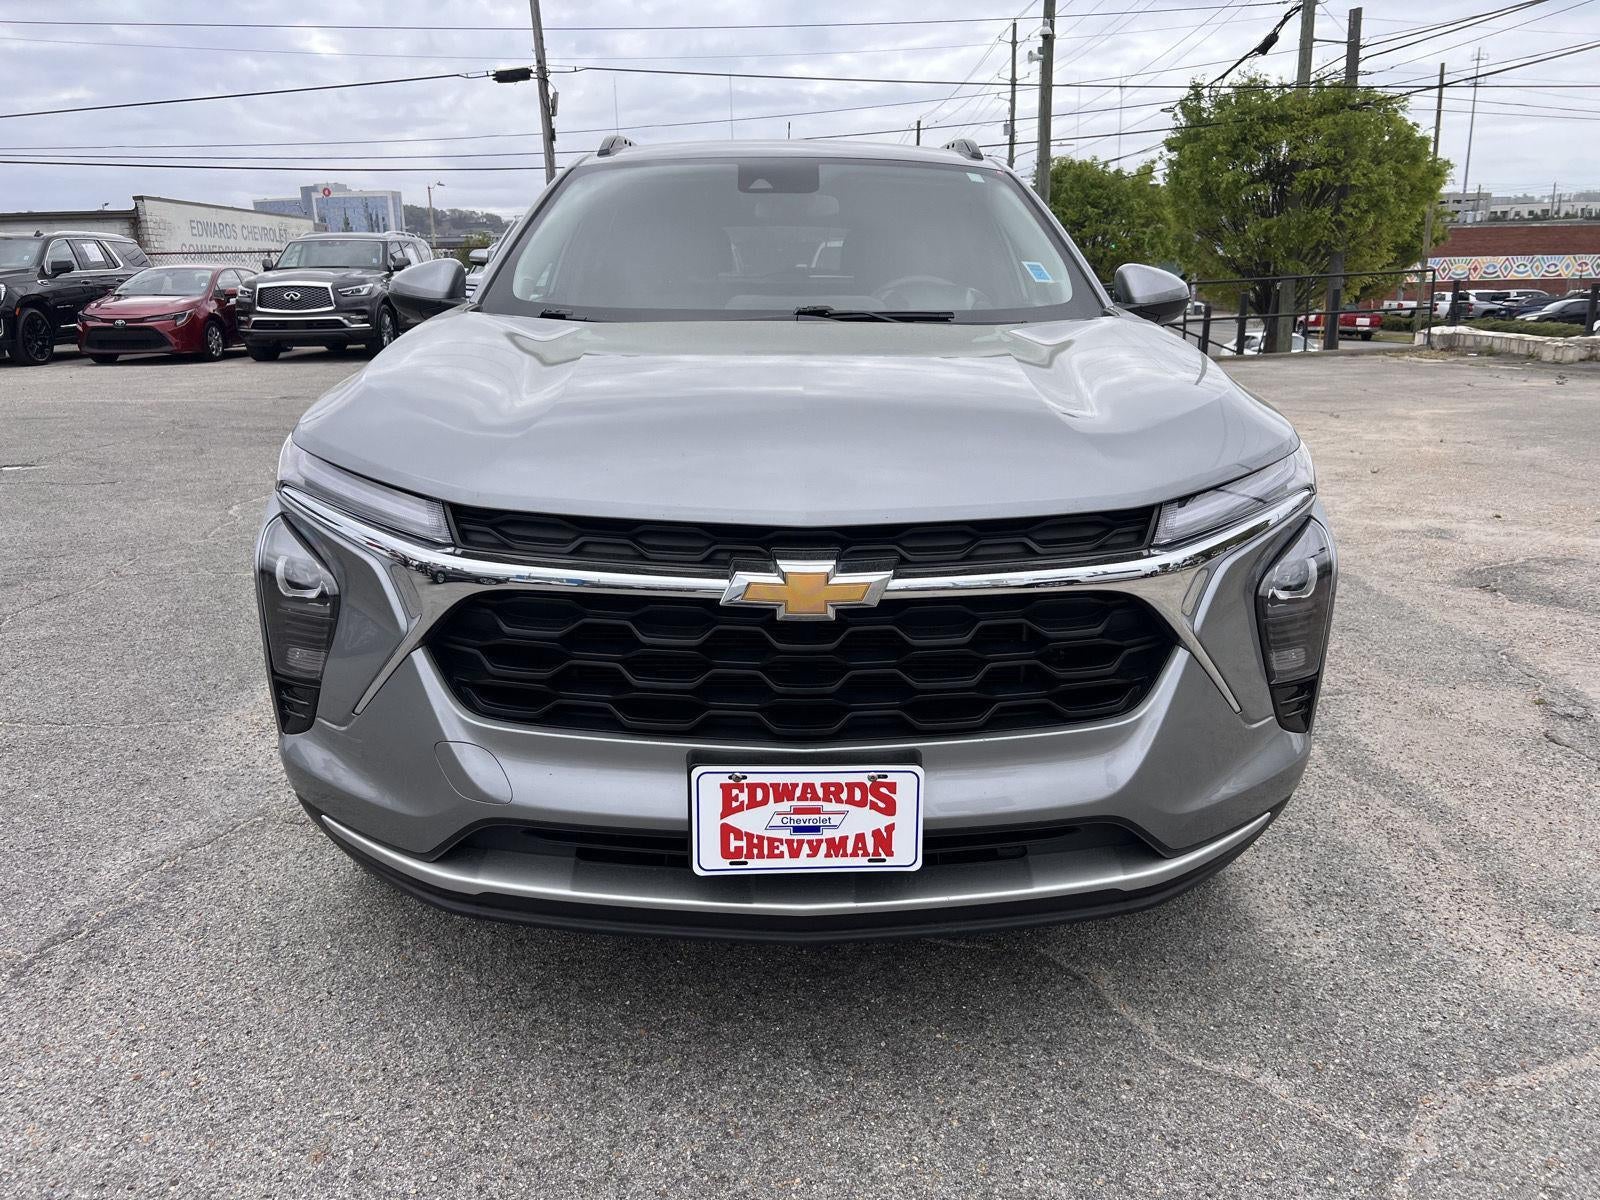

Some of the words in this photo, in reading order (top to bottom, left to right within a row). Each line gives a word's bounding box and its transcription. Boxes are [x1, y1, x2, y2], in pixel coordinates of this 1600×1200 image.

[190, 219, 238, 241] EDWARDS
[241, 224, 288, 244] CHEVROLET
[720, 781, 897, 820] EDWARDS
[780, 816, 832, 825] Chevrolet
[720, 821, 896, 860] CHEVYMAN
